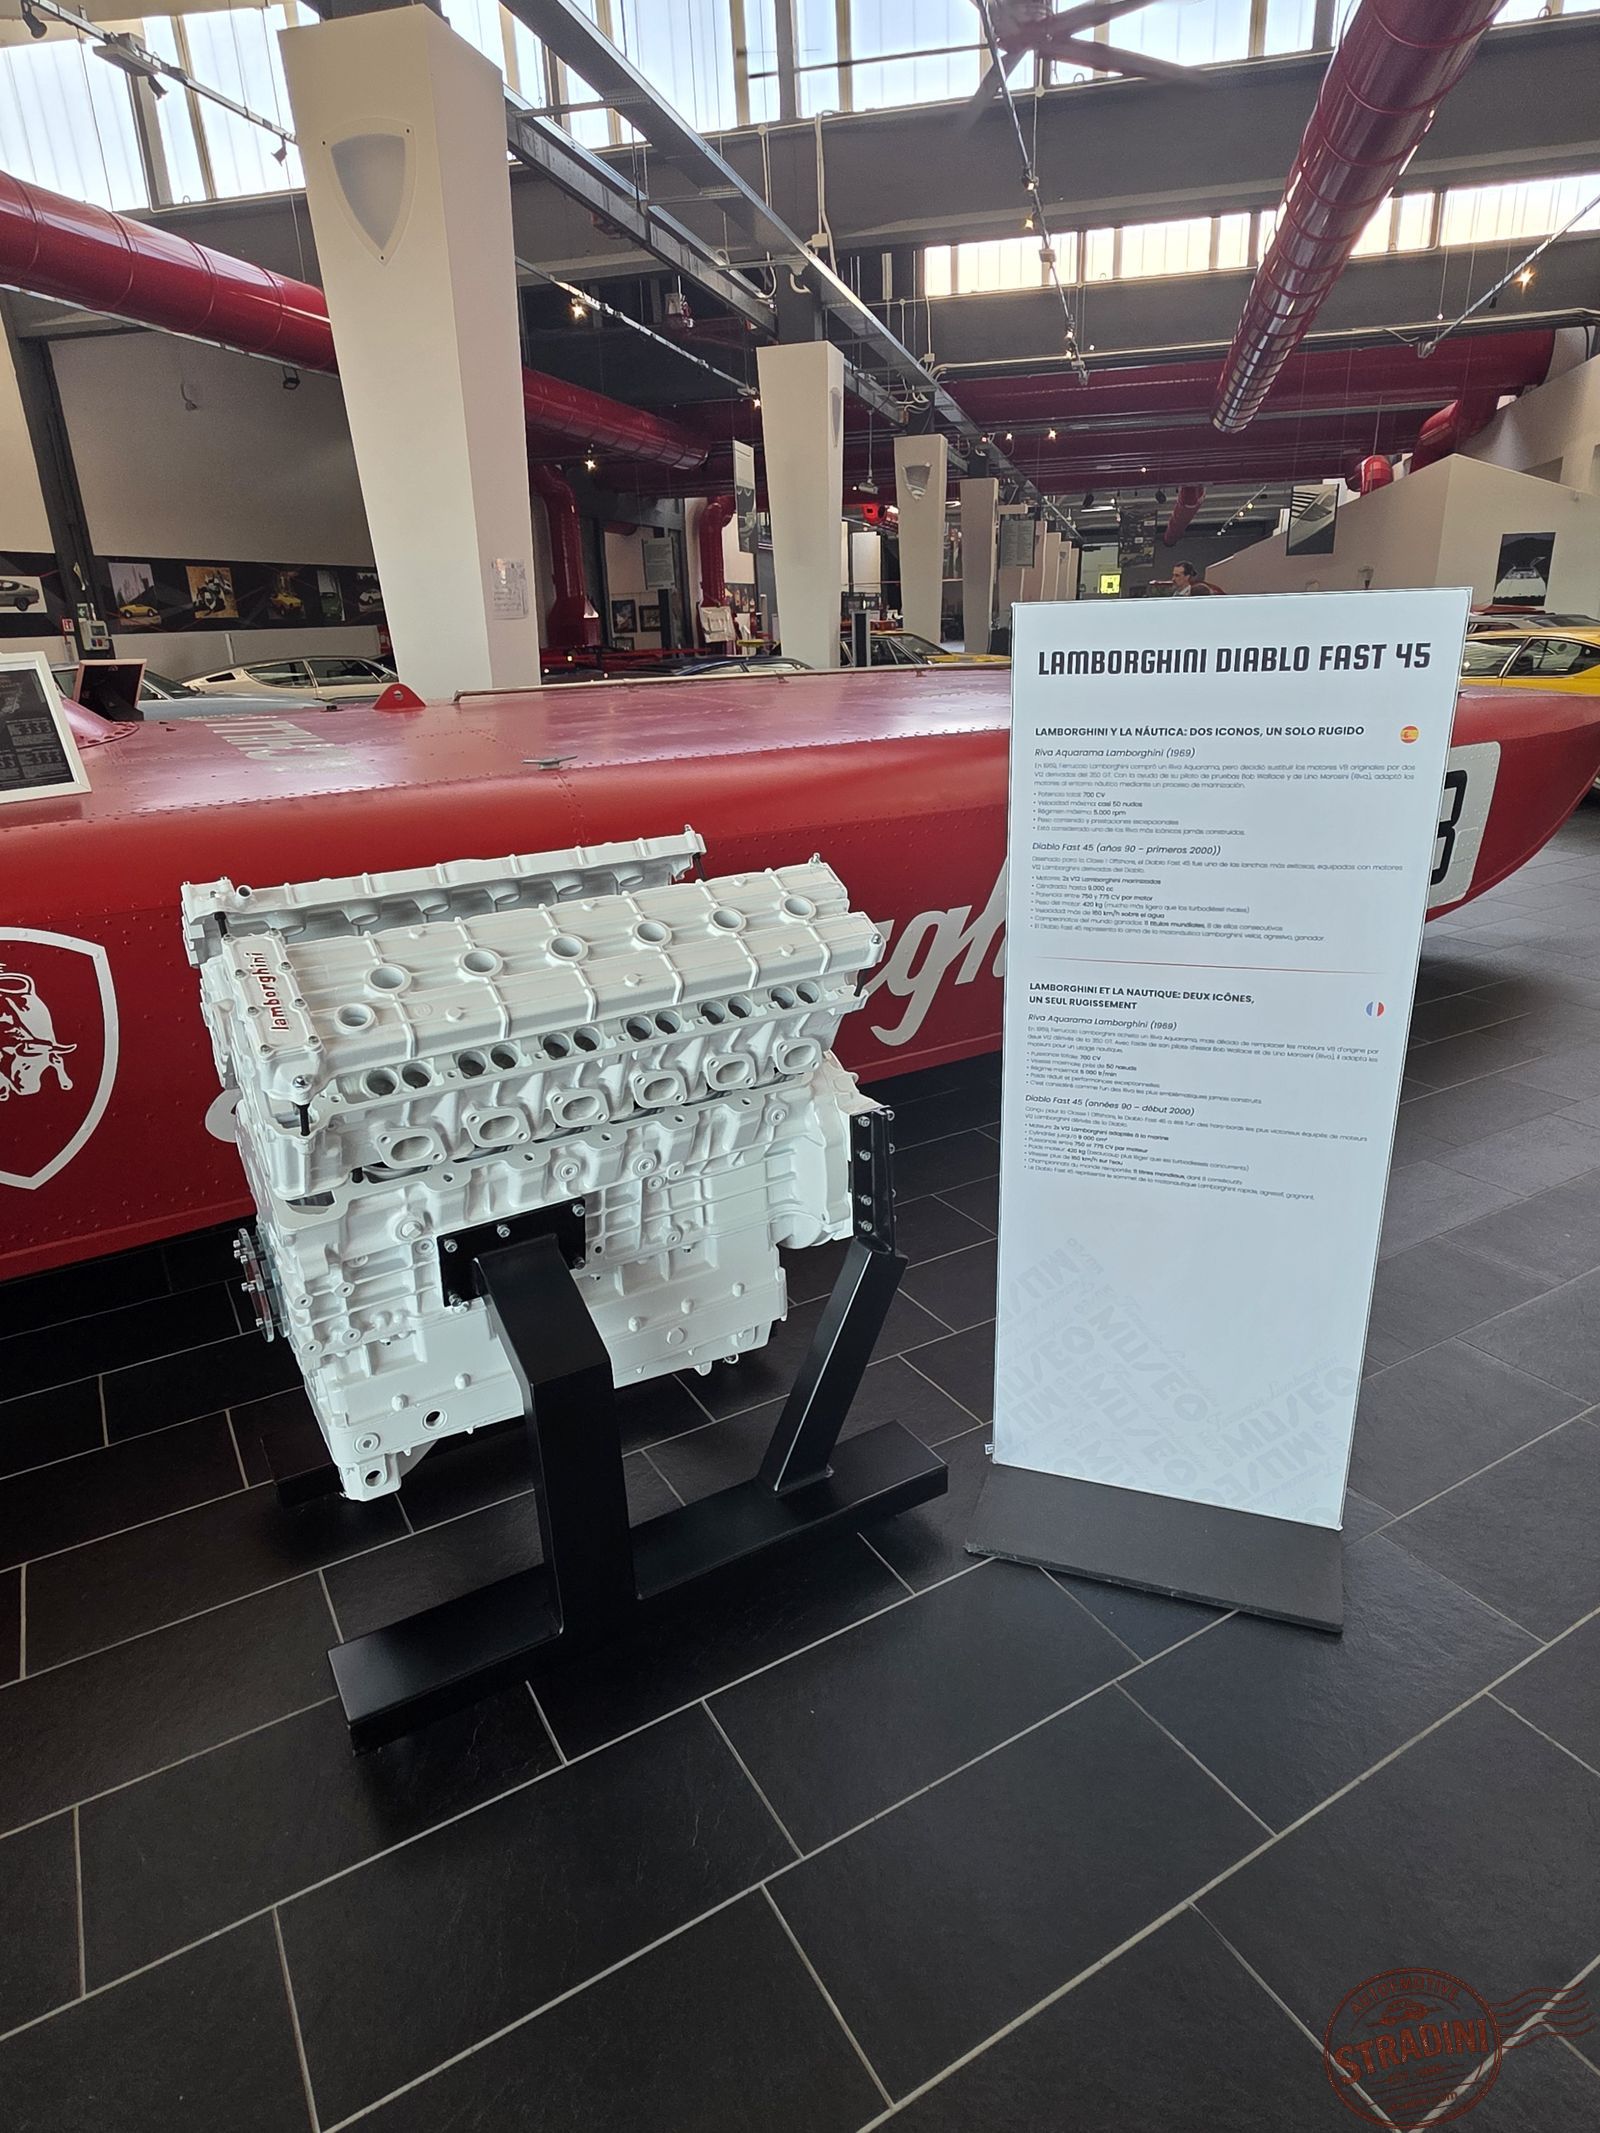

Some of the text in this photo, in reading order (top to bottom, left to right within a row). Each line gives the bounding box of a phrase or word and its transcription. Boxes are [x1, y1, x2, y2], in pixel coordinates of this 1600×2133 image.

[1038, 643, 1431, 675] LAMBORGHINI DIABLO FAST 45
[1035, 725, 1364, 737] LAMBORGHINI Y LA NÁUTICA: DOS ICONOS, UN SOLO RUGIDO
[1035, 747, 1196, 759] Riva Aquarama Lamborghini (1969)
[1032, 842, 1060, 851] Diablo
[1062, 843, 1080, 851] Fast
[1097, 843, 1122, 853] (años
[1124, 844, 1136, 852] 90
[1146, 845, 1187, 855] primeros
[1190, 846, 1221, 857] 2000))
[245, 952, 289, 1030] lamborghini
[1030, 983, 1097, 994] LAMBORGHINI
[1112, 987, 1124, 995] LA
[1127, 988, 1181, 999] NAUTIQUE:
[1183, 991, 1209, 1001] DEUX
[1212, 992, 1255, 1004] ICÔNES,
[1045, 997, 1067, 1005] SEUL
[1069, 998, 1137, 1009] RUGISSEMENT
[1028, 1014, 1177, 1030] Riva Aquarama Lamborghini (1969)
[1025, 1094, 1051, 1103] Diablo
[1085, 1099, 1119, 1109] (années
[1121, 1102, 1132, 1110] 90
[1169, 1107, 1195, 1117] 2000)
